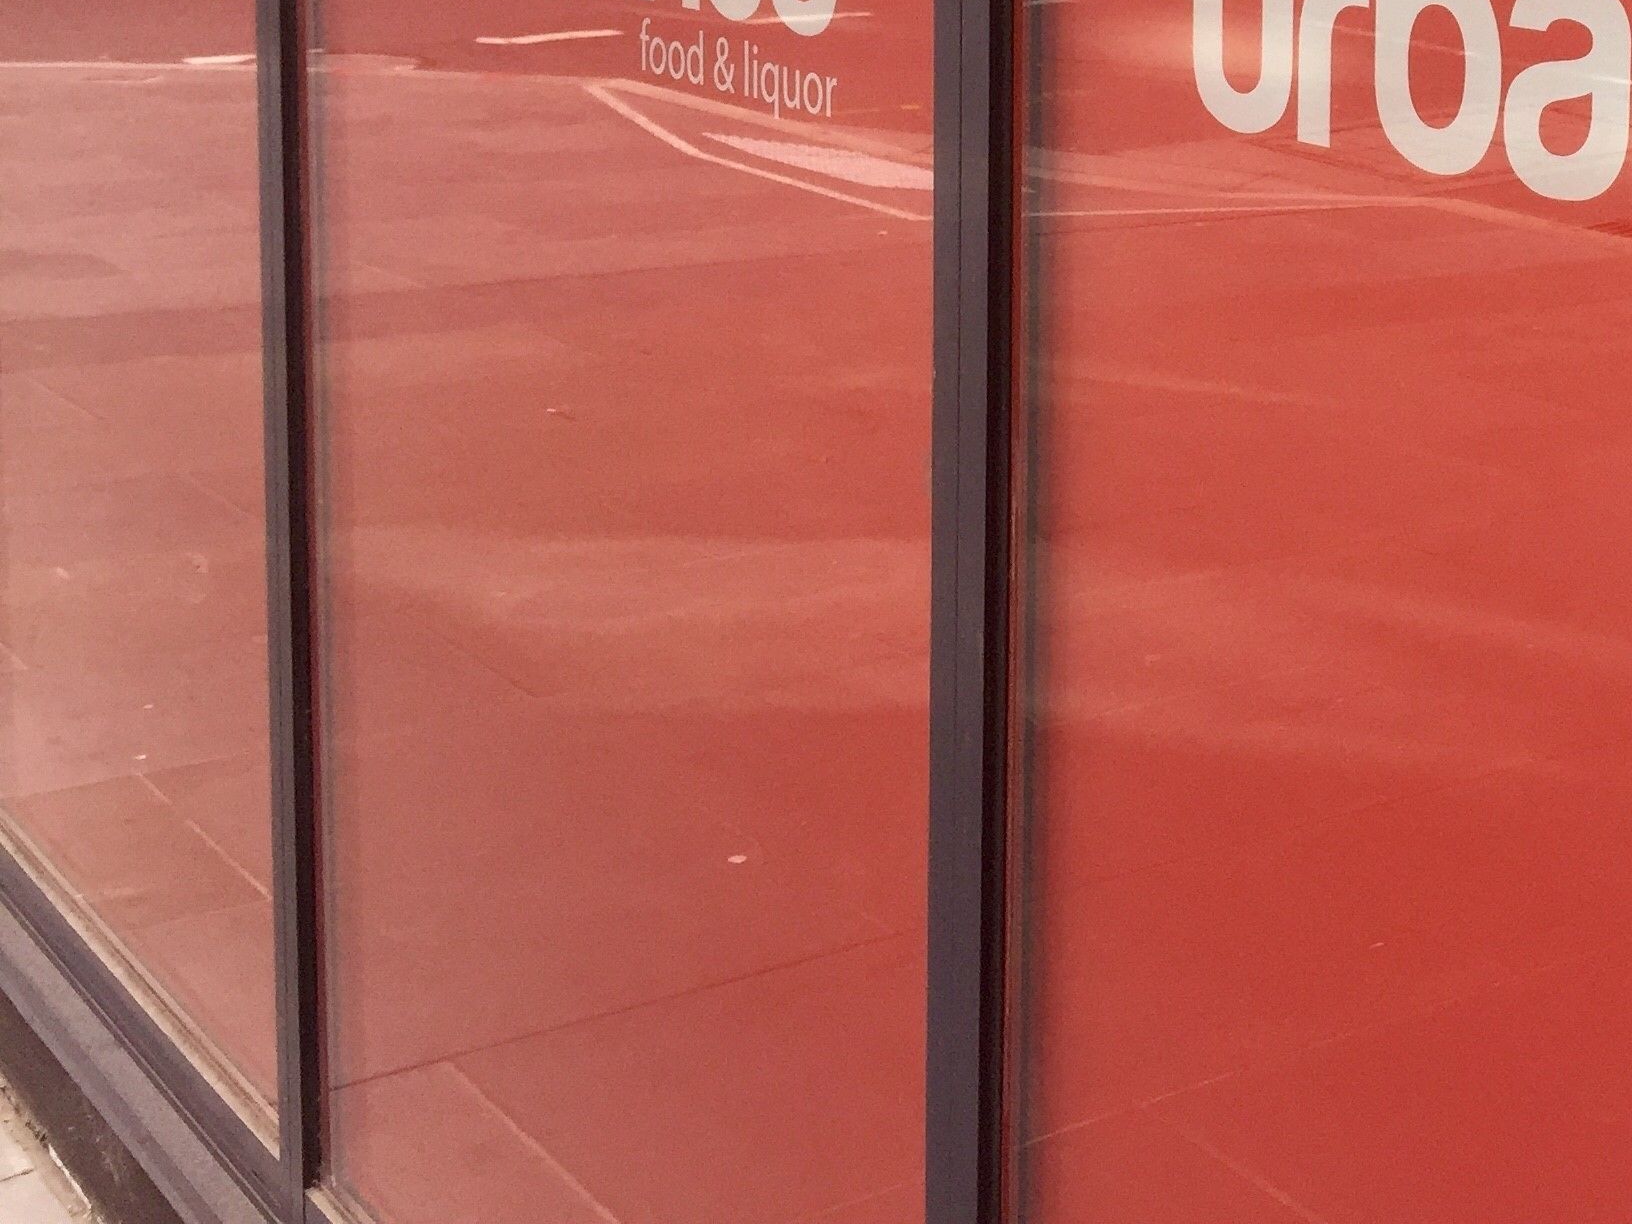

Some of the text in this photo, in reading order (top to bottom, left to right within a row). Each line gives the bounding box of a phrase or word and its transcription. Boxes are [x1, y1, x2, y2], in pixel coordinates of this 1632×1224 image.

[639, 18, 838, 120] food & liquor
